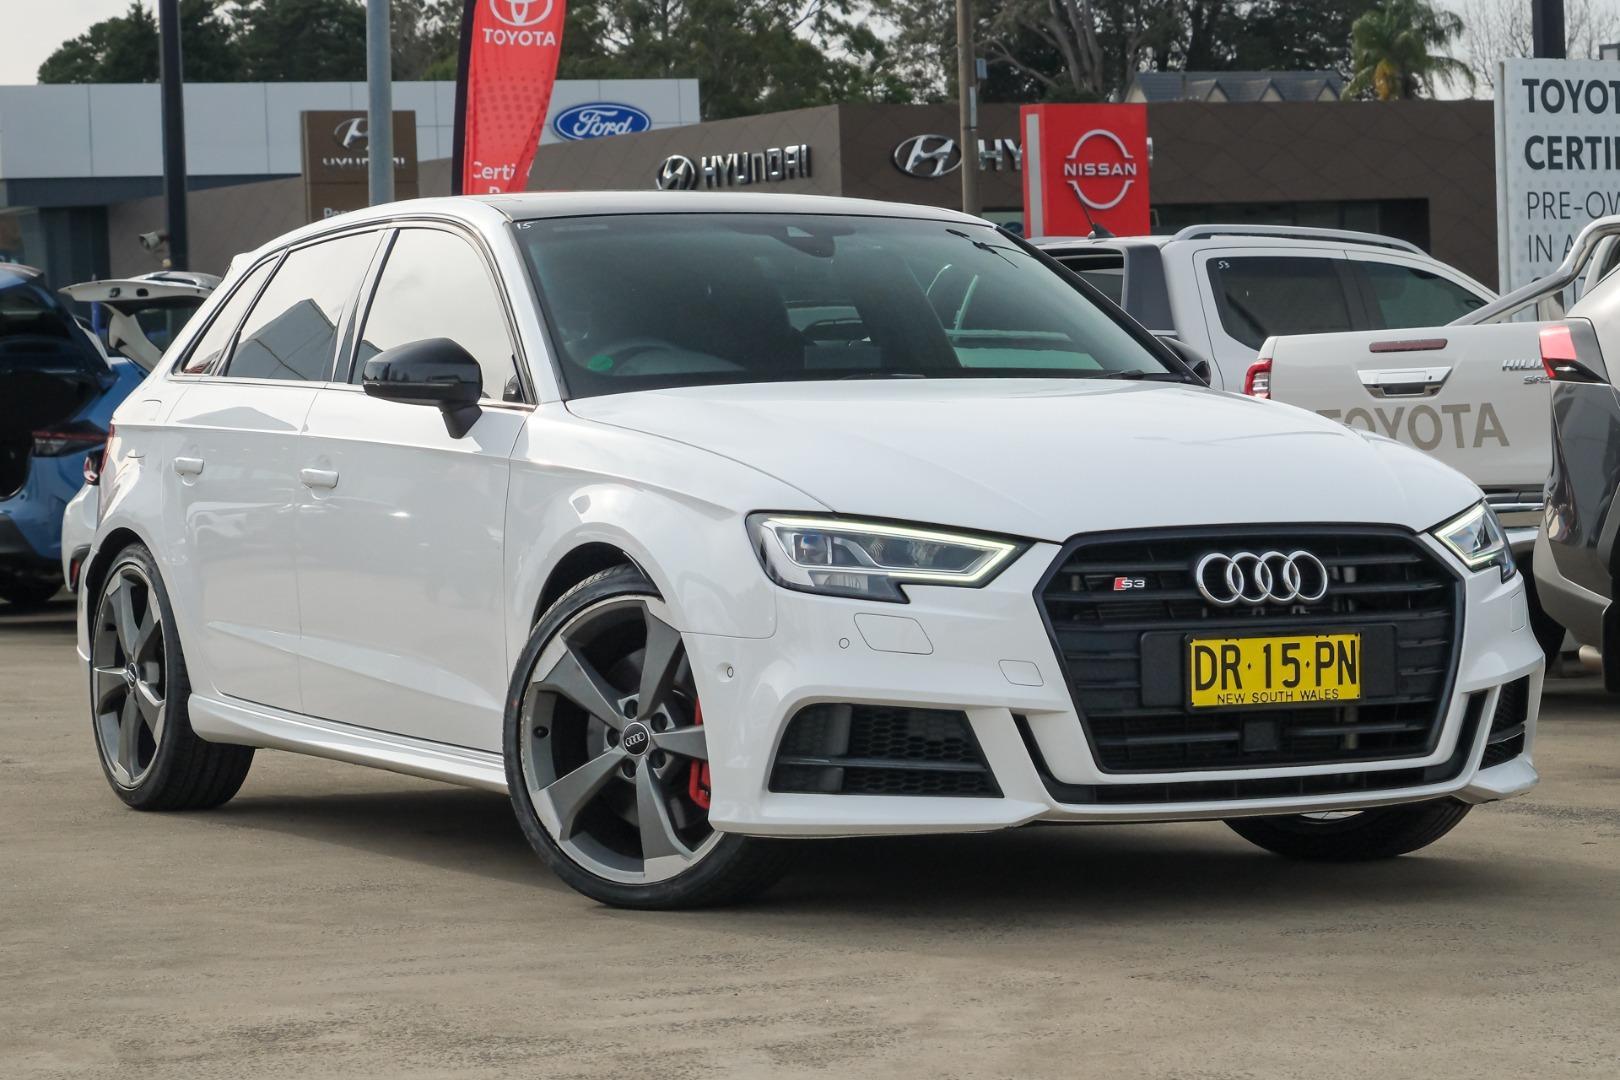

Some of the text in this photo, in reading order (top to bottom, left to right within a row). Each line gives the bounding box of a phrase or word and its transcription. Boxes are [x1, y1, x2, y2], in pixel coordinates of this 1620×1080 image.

[482, 28, 556, 46] TOYOTA
[573, 109, 633, 136] Ford
[701, 144, 808, 187] HYUNDAI
[1064, 163, 1137, 176] NISSAN
[1528, 234, 1552, 262] IN
[1502, 359, 1543, 370] HILU
[1217, 688, 1339, 704] NEW SOUTH WALES
